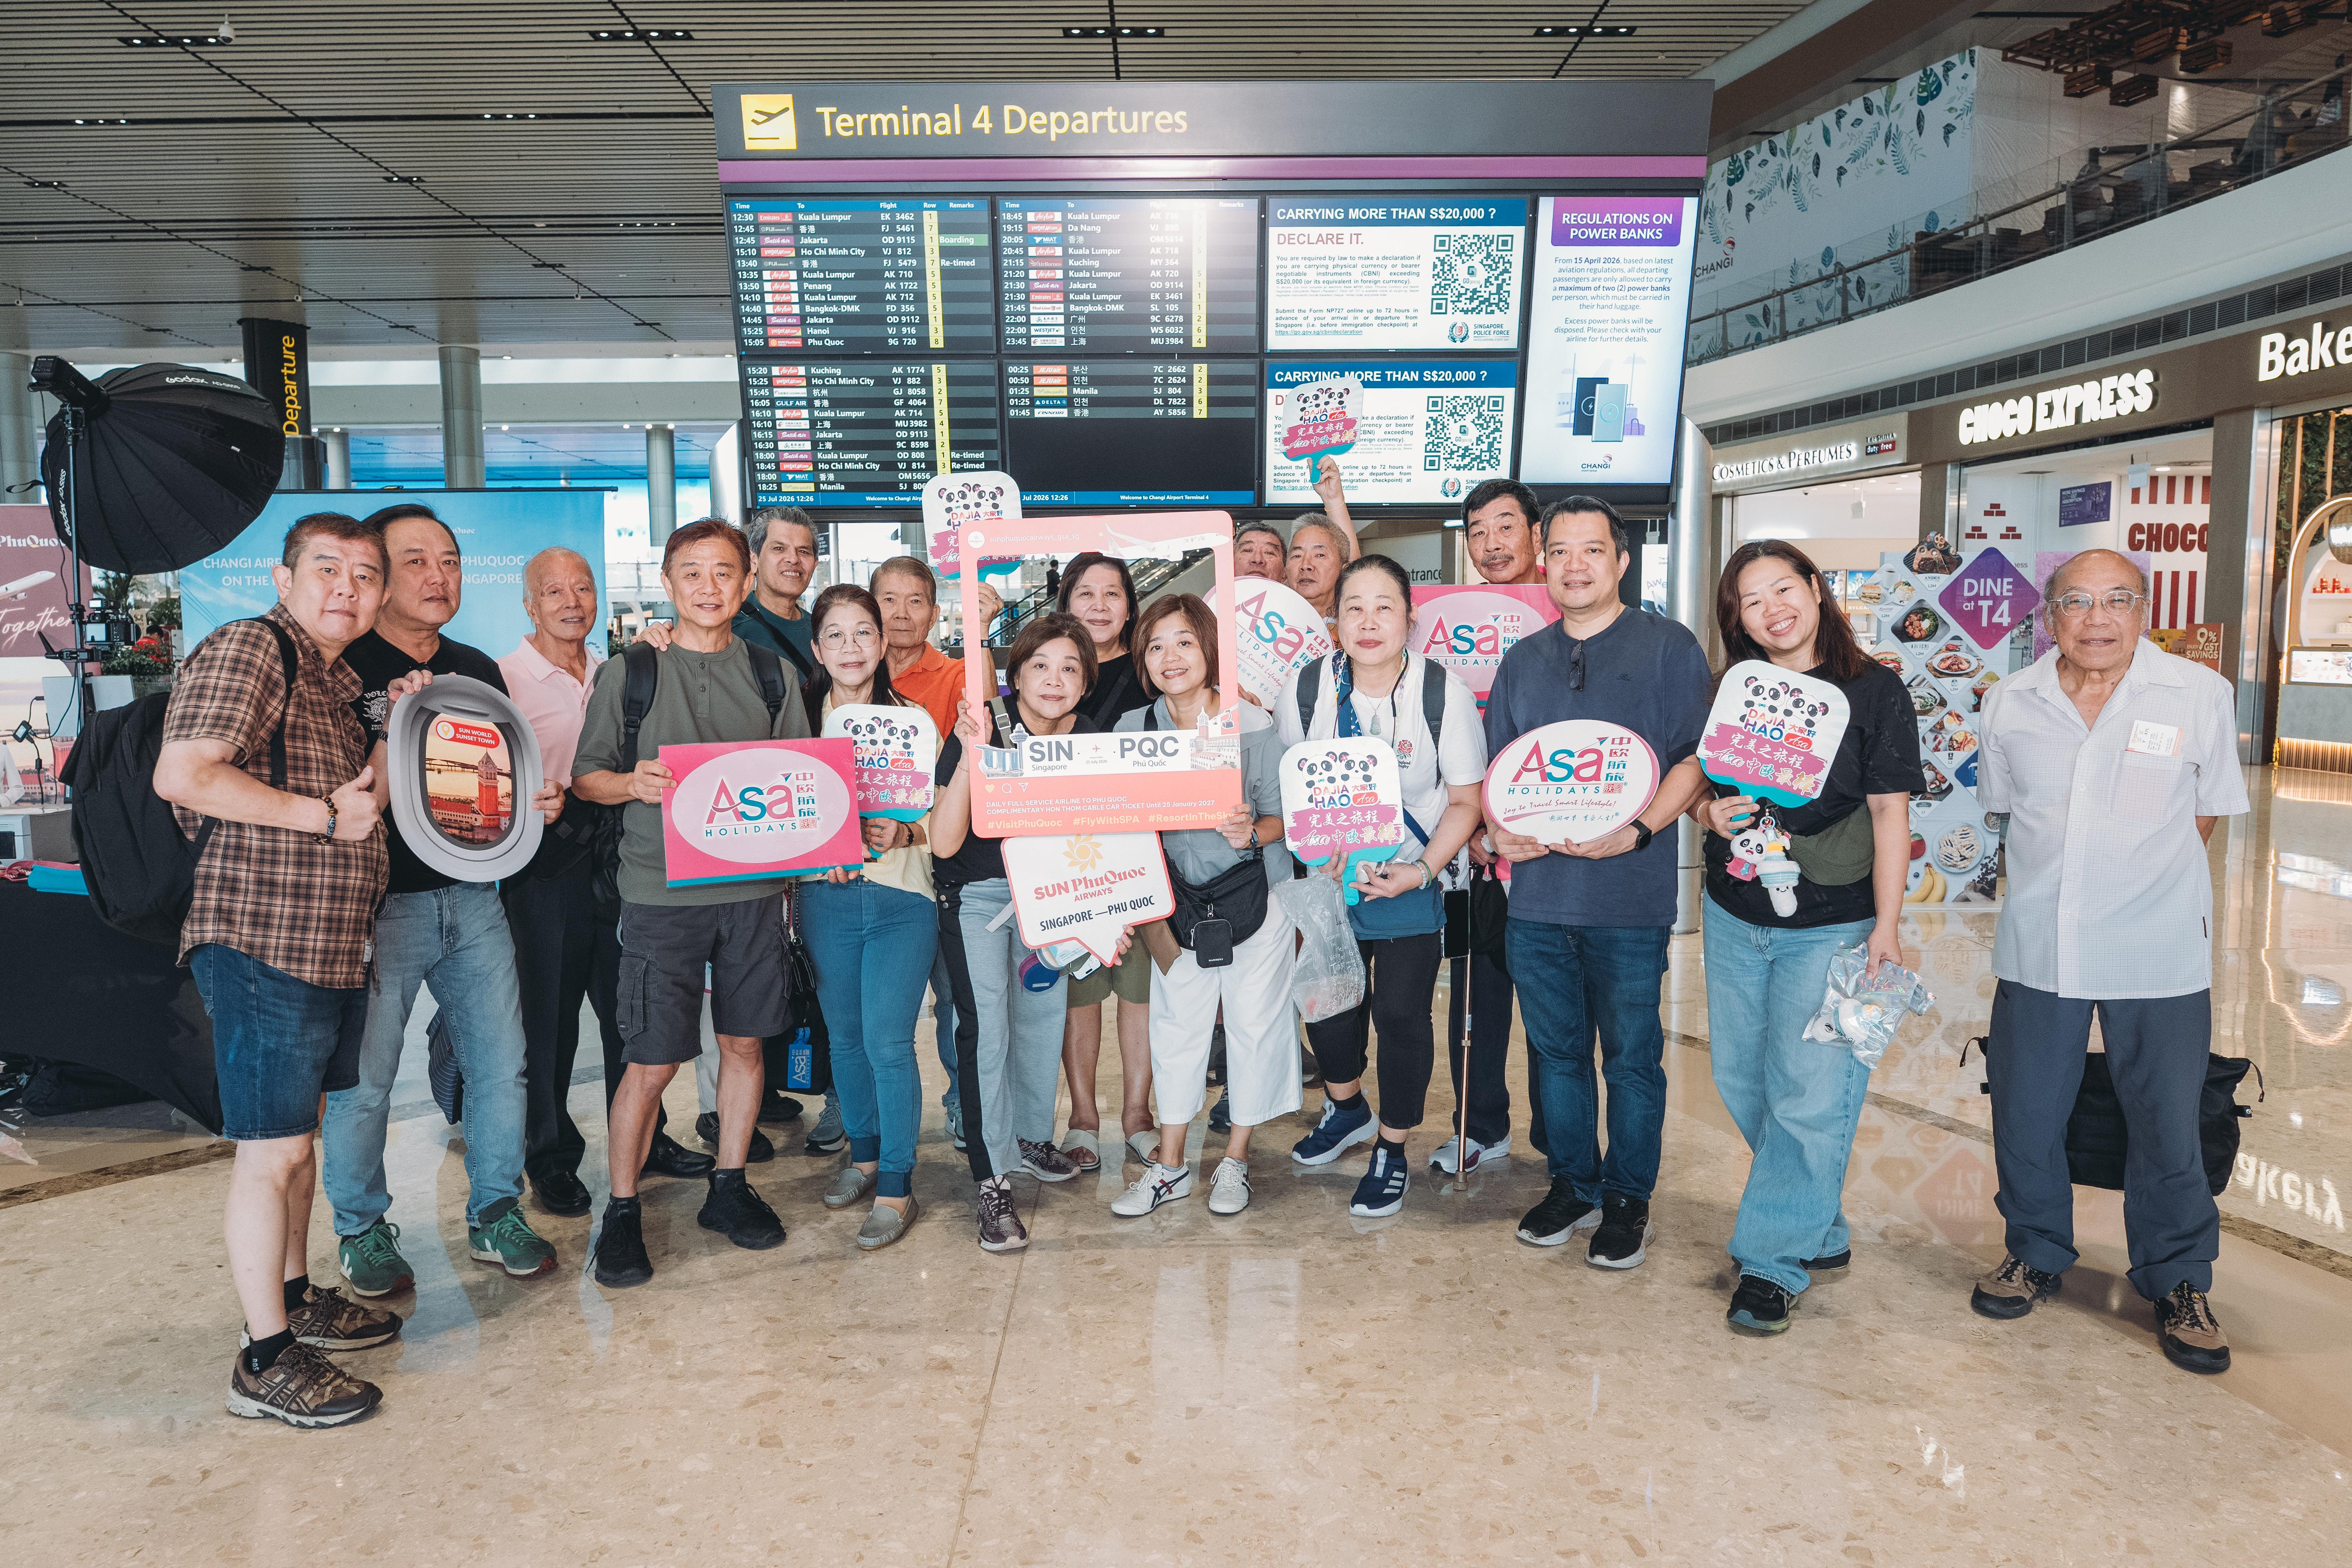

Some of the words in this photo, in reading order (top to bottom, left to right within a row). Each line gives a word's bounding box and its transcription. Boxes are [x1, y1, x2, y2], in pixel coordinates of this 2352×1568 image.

[816, 103, 961, 137] Terminal
[972, 104, 993, 135] 4
[1003, 104, 1188, 142] Departures
[732, 213, 754, 222] 12:30
[822, 212, 851, 222] Lumpur
[895, 212, 914, 221] 3462
[1277, 208, 1344, 220] CARRYING
[1348, 208, 1387, 219] MORE
[1390, 208, 1426, 219] THAN
[1429, 207, 1485, 220] S$20,000
[1488, 207, 1496, 219] ?
[1562, 213, 1650, 224] REGULATIONS
[1652, 213, 1673, 224] ON
[734, 236, 756, 245] 12:45
[896, 235, 916, 244] 9115
[939, 235, 974, 245] Boarding
[1277, 233, 1344, 245] DECLARE
[1349, 233, 1364, 245] IT.
[1570, 228, 1617, 240] POWER
[1620, 228, 1663, 240] BANKS
[1584, 257, 1601, 265] April
[1695, 256, 1733, 278] CHANGI
[1006, 326, 1026, 335] 22:00
[1070, 325, 1086, 335] 인천
[1165, 326, 1184, 334] 6032
[743, 338, 764, 347] 15:05
[807, 338, 822, 346] Phu
[823, 338, 844, 347] Quoc
[165, 375, 209, 384] Godox
[282, 335, 299, 436] Departure
[813, 399, 829, 408] 香港
[1958, 397, 2033, 446] CHOCO
[2035, 369, 2155, 433] EXPRESS
[1867, 445, 1879, 454] duty
[1712, 458, 1774, 481] COSMETICS
[1777, 456, 1786, 469] &
[1789, 444, 1852, 468] PERFUMES
[59, 500, 72, 537] Godox
[0, 534, 66, 548] PhuQuo
[989, 533, 1079, 543] sunphuquocairways_gsa_sg
[203, 557, 253, 570] CHANGI
[461, 555, 525, 566] PHUQUOC
[222, 576, 242, 587] ON
[245, 575, 268, 587] THE
[462, 573, 523, 584] NGAPORE
[1407, 568, 1442, 582] ntrance
[1963, 578, 2013, 597] DINE
[1963, 601, 1974, 611] at
[1978, 600, 2011, 627] T4
[2204, 642, 2220, 651] GST
[2186, 650, 2219, 660] SAVINGS
[456, 733, 477, 742] SUNSET
[477, 737, 495, 745] TOWN
[471, 729, 492, 738] WORLD
[1029, 740, 1073, 763] SIN
[1120, 736, 1179, 758] PQC
[1032, 763, 1068, 772] Singapore
[1148, 758, 1167, 768] Quốc
[1511, 739, 1604, 783] Asa
[1313, 784, 1349, 796] DAJIA
[1351, 783, 1377, 792] 大家好
[1508, 785, 1600, 795] HOLIDAYS
[705, 778, 795, 824] Asa
[1314, 794, 1351, 809] HAO
[1356, 793, 1377, 804] Asa
[1530, 800, 1552, 810] Travel
[1581, 799, 1617, 809] Lifestyle!
[987, 818, 1063, 830] #VisitPhuQuoc
[1073, 815, 1140, 827] #FlyWithSPA
[1308, 810, 1380, 828] 完美之旅程
[705, 822, 797, 837] HOLIDAYS
[1299, 829, 1330, 847] Asa
[1332, 823, 1398, 846] 中欧最棒
[1034, 881, 1070, 900] SUN
[1070, 867, 1147, 892] PhuQuoc
[1074, 887, 1113, 902] AIRWAYS
[1040, 910, 1093, 931] SINGAPORE
[1130, 895, 1155, 910] QUOC
